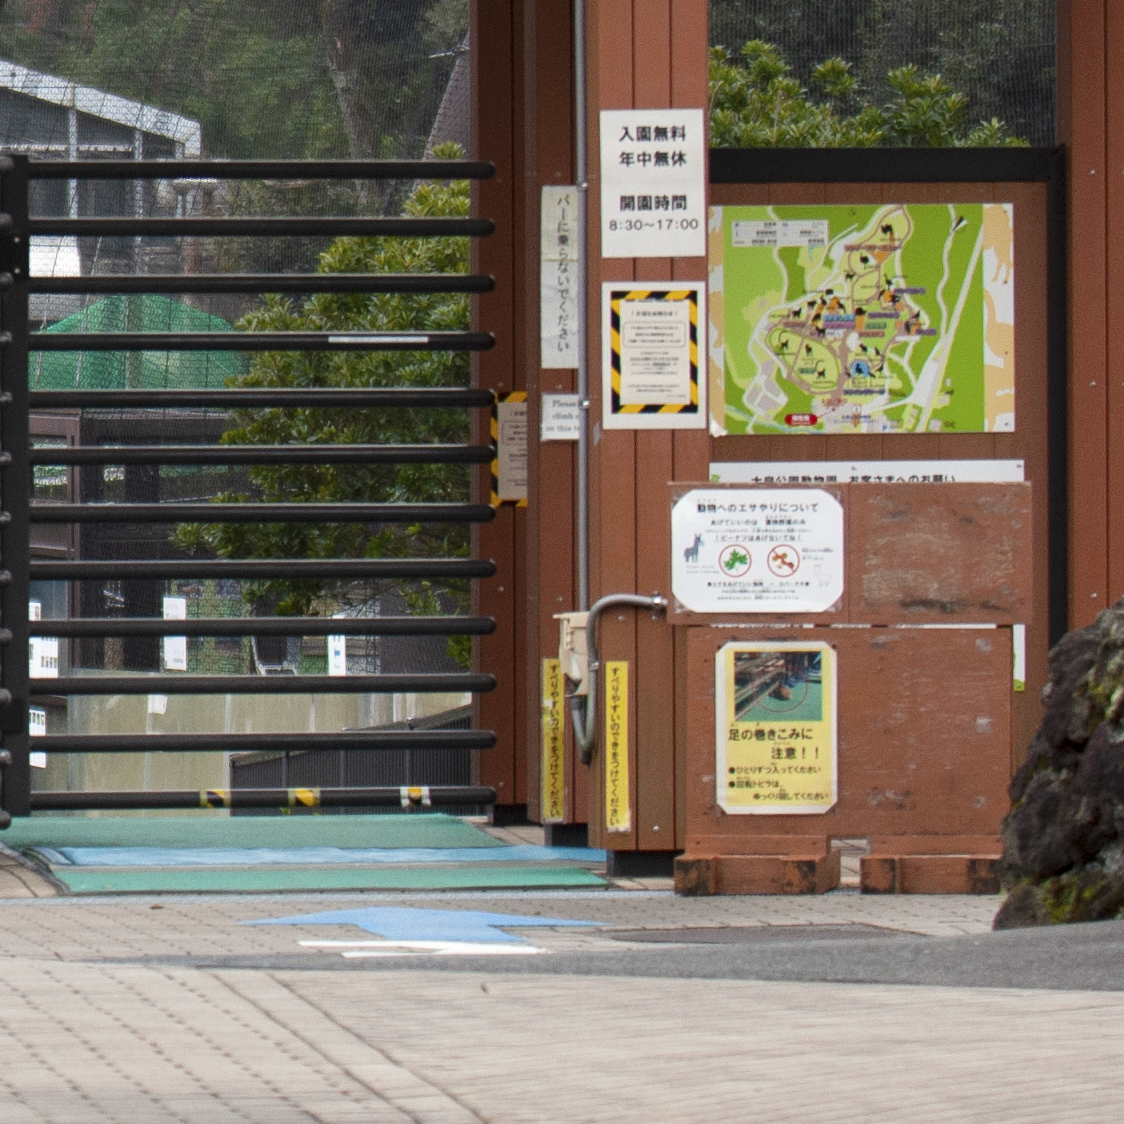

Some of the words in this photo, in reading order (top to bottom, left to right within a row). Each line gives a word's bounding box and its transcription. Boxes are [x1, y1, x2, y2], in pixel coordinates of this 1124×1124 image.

[619, 125, 687, 142] 入園無料
[619, 151, 687, 167] 年中無休
[619, 195, 687, 212] 開園時間
[557, 193, 570, 353] バーに乗らないでください
[697, 502, 819, 514] 動物へのエサやりについて
[728, 728, 813, 741] 足の巻きこみに
